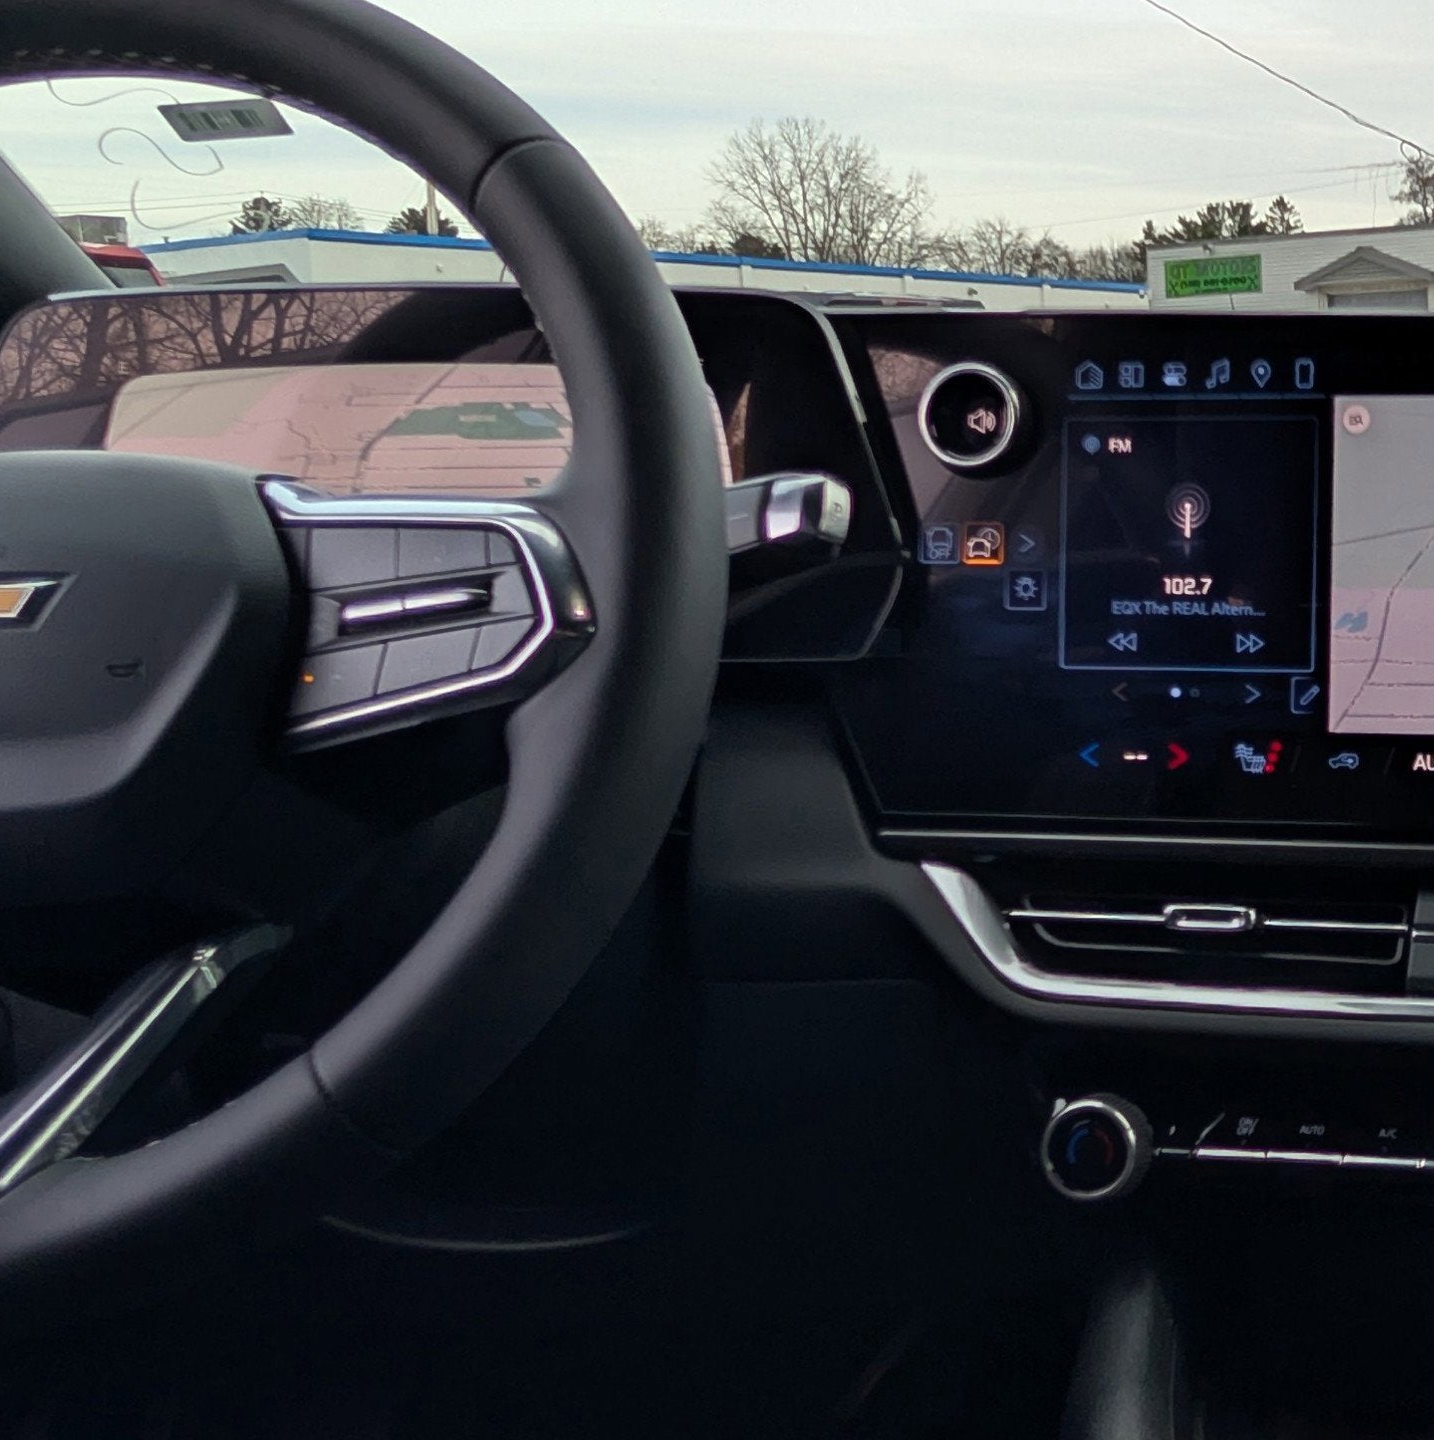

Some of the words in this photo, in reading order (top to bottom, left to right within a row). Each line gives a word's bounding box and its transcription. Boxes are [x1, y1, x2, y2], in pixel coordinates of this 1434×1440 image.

[1108, 437, 1133, 454] FM
[1163, 576, 1213, 595] 102.7
[1143, 600, 1169, 615] The
[1172, 601, 1209, 616] REAL
[1299, 1124, 1326, 1136] AUTO
[1378, 1127, 1399, 1140] A/C
